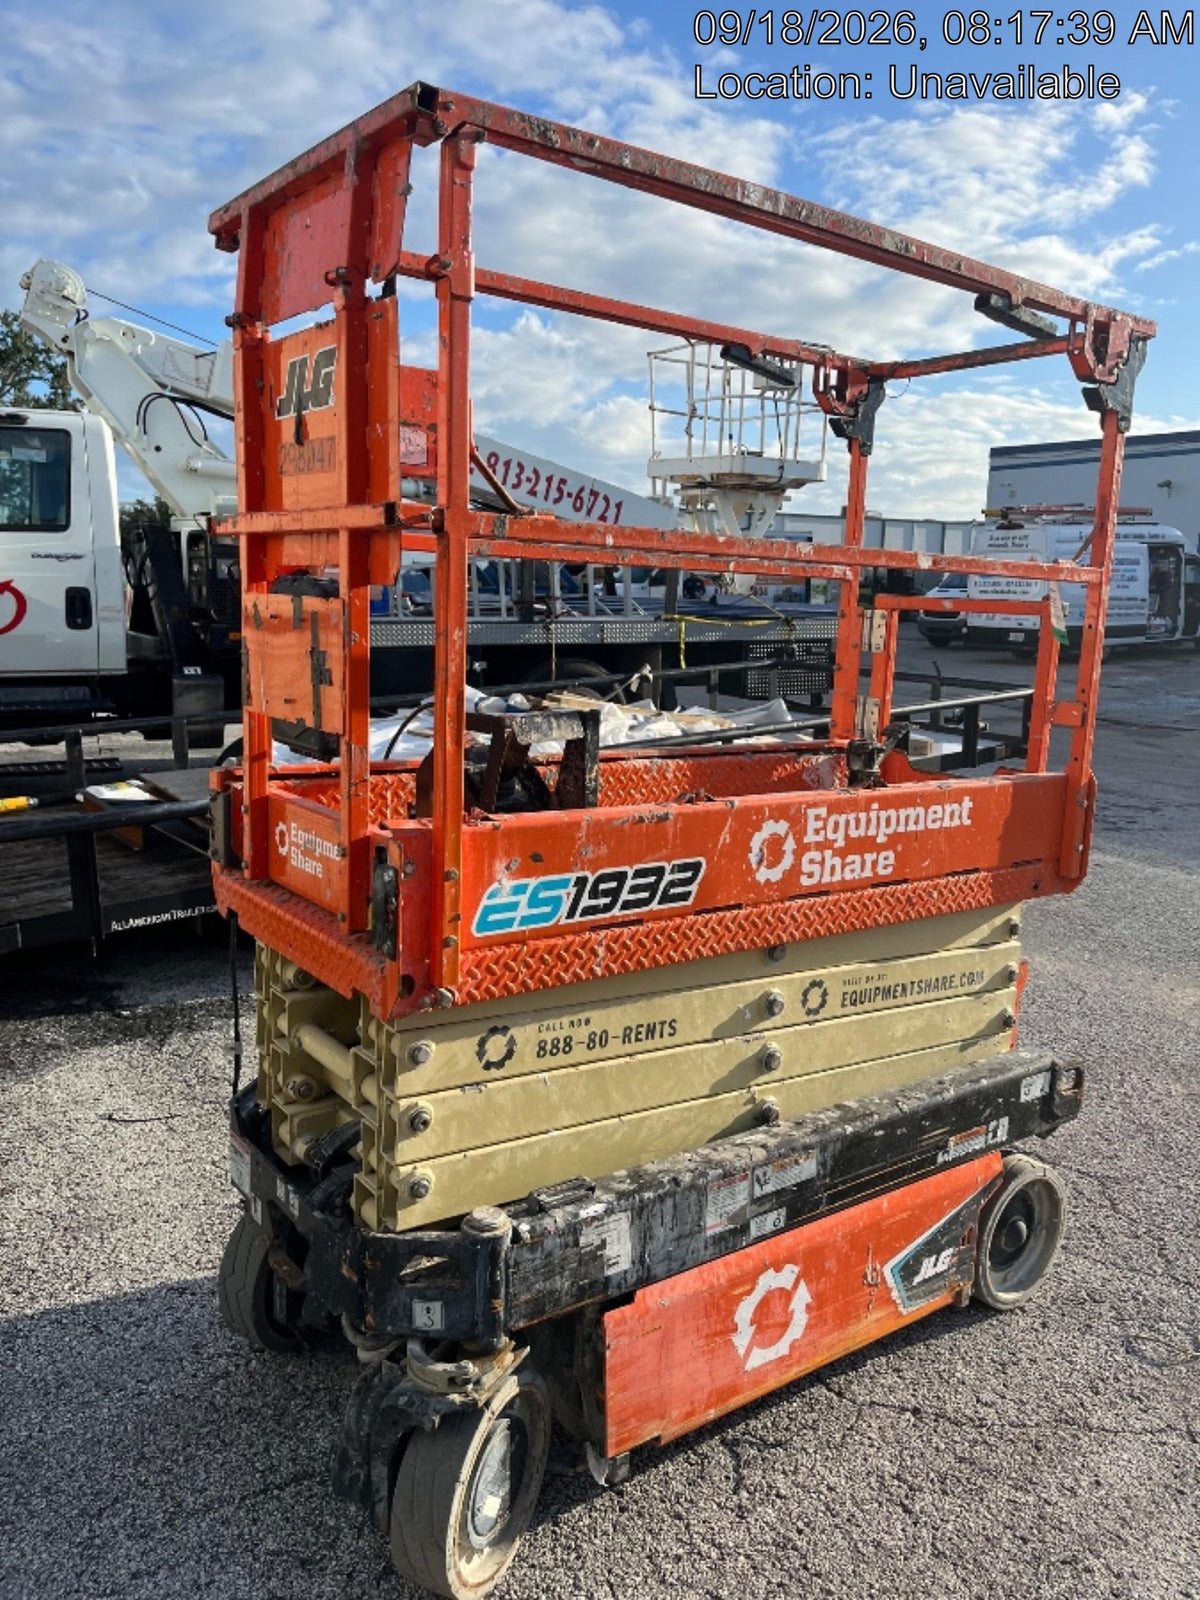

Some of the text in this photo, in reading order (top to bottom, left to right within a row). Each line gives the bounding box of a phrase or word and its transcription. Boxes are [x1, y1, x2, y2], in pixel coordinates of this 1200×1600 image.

[275, 344, 338, 421] JLG
[486, 451, 624, 525] 813-215-6721
[290, 822, 342, 861] Equipme
[803, 796, 974, 849] Equipment
[290, 845, 324, 879] Share
[800, 849, 896, 886] Share
[471, 857, 706, 937] ES1932
[840, 970, 985, 1009] EQUIPMENTSHARE.COM
[536, 1018, 678, 1059] 888-80-RENTS
[537, 1016, 592, 1033] CALL NOW
[912, 1247, 954, 1286] JLG
